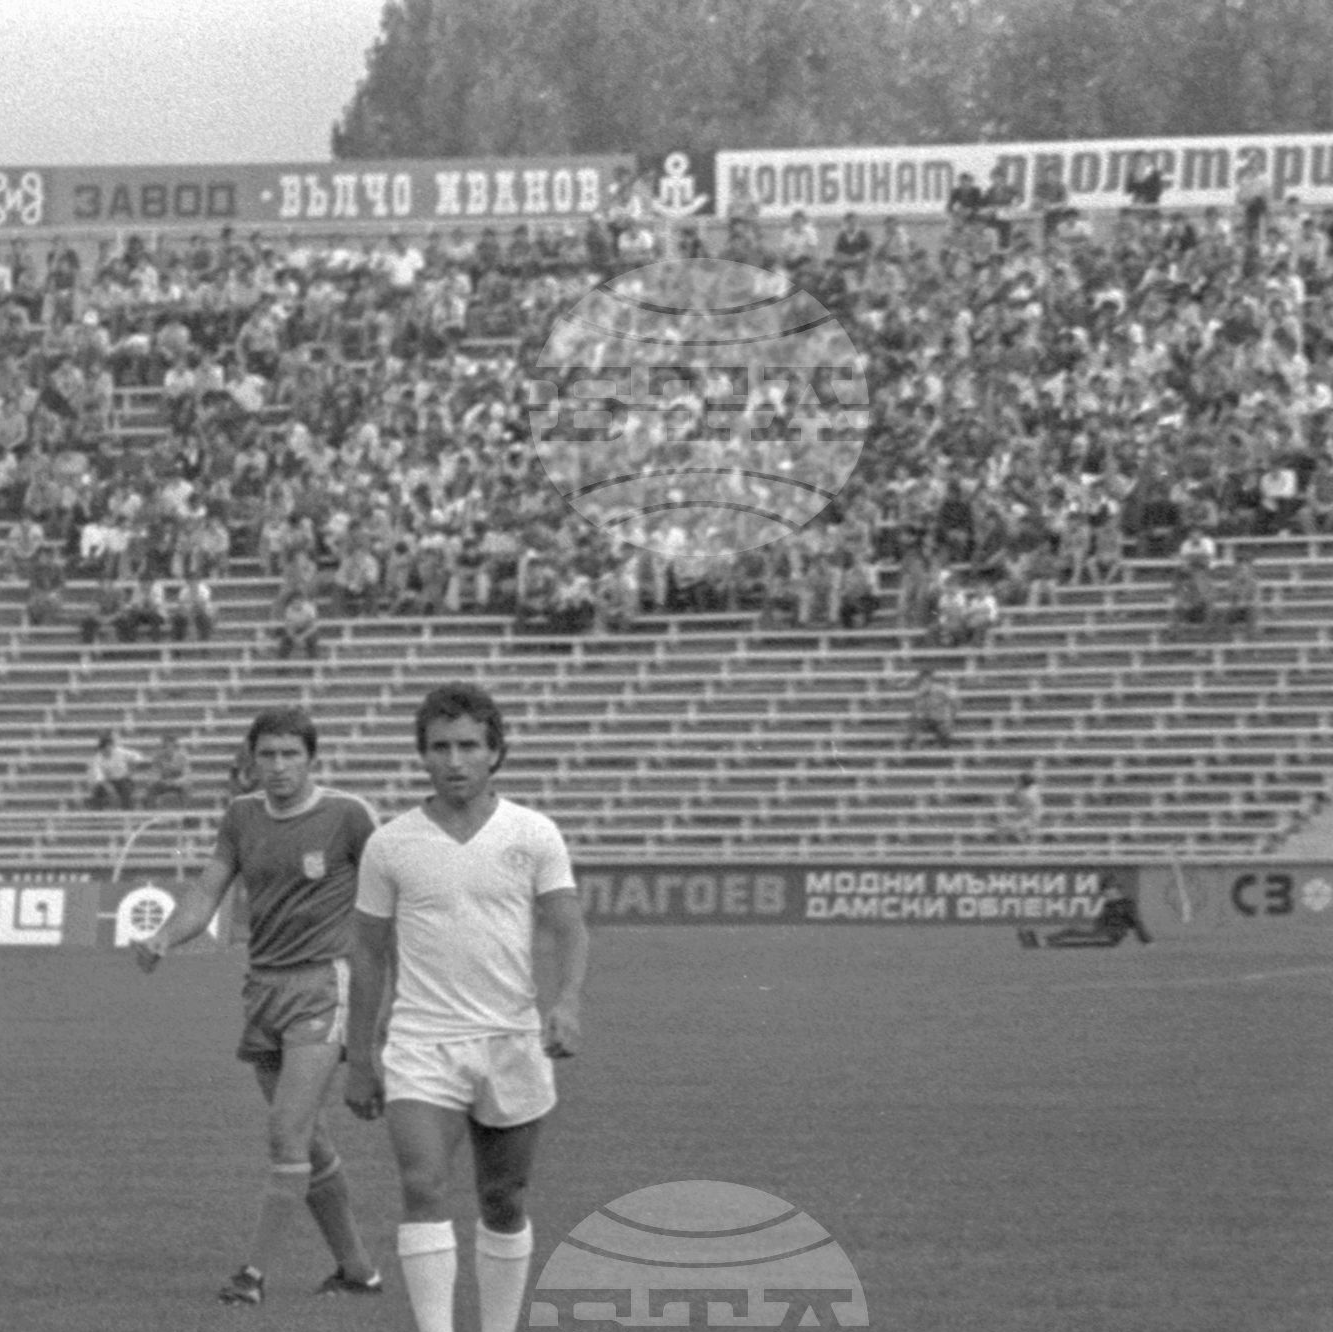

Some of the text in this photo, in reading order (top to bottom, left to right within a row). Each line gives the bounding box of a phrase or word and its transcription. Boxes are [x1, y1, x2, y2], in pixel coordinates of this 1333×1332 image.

[73, 168, 600, 220] ЗАВОД ВЪЛЧО ИВАНОВ
[580, 874, 785, 916] ЛАГОЕВ
[806, 871, 926, 895] МОДНИ
[1075, 871, 1100, 893] И
[806, 895, 947, 919] ДАМСКИ
